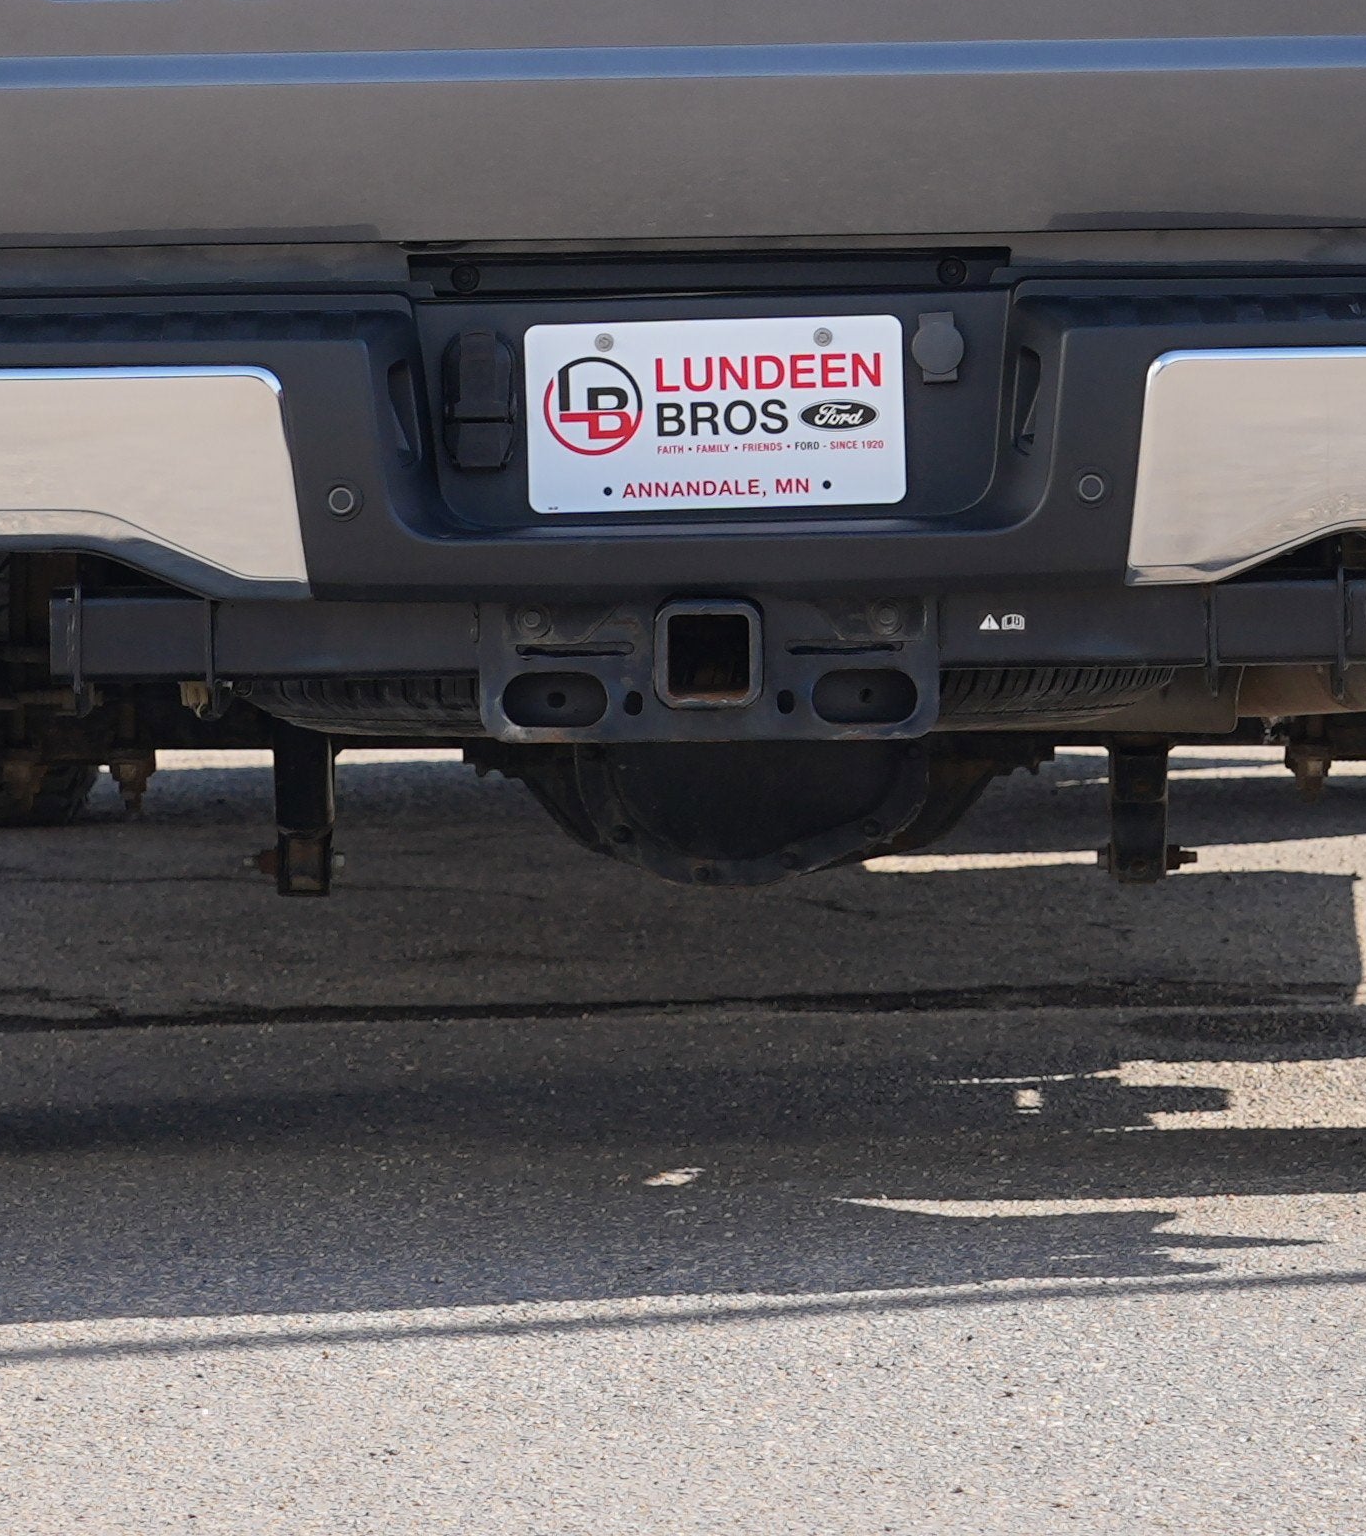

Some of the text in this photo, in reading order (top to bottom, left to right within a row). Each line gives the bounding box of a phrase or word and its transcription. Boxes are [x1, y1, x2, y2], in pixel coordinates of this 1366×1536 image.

[655, 353, 882, 393] LUNDEEN
[656, 398, 864, 438] BROS Ford
[657, 445, 684, 455] FAITH
[696, 443, 730, 454] FAMILY
[742, 442, 783, 452] FRIENDS
[794, 441, 820, 451] FORD
[830, 440, 858, 450] SINCE
[622, 478, 810, 498] ANNANDALE, MN
